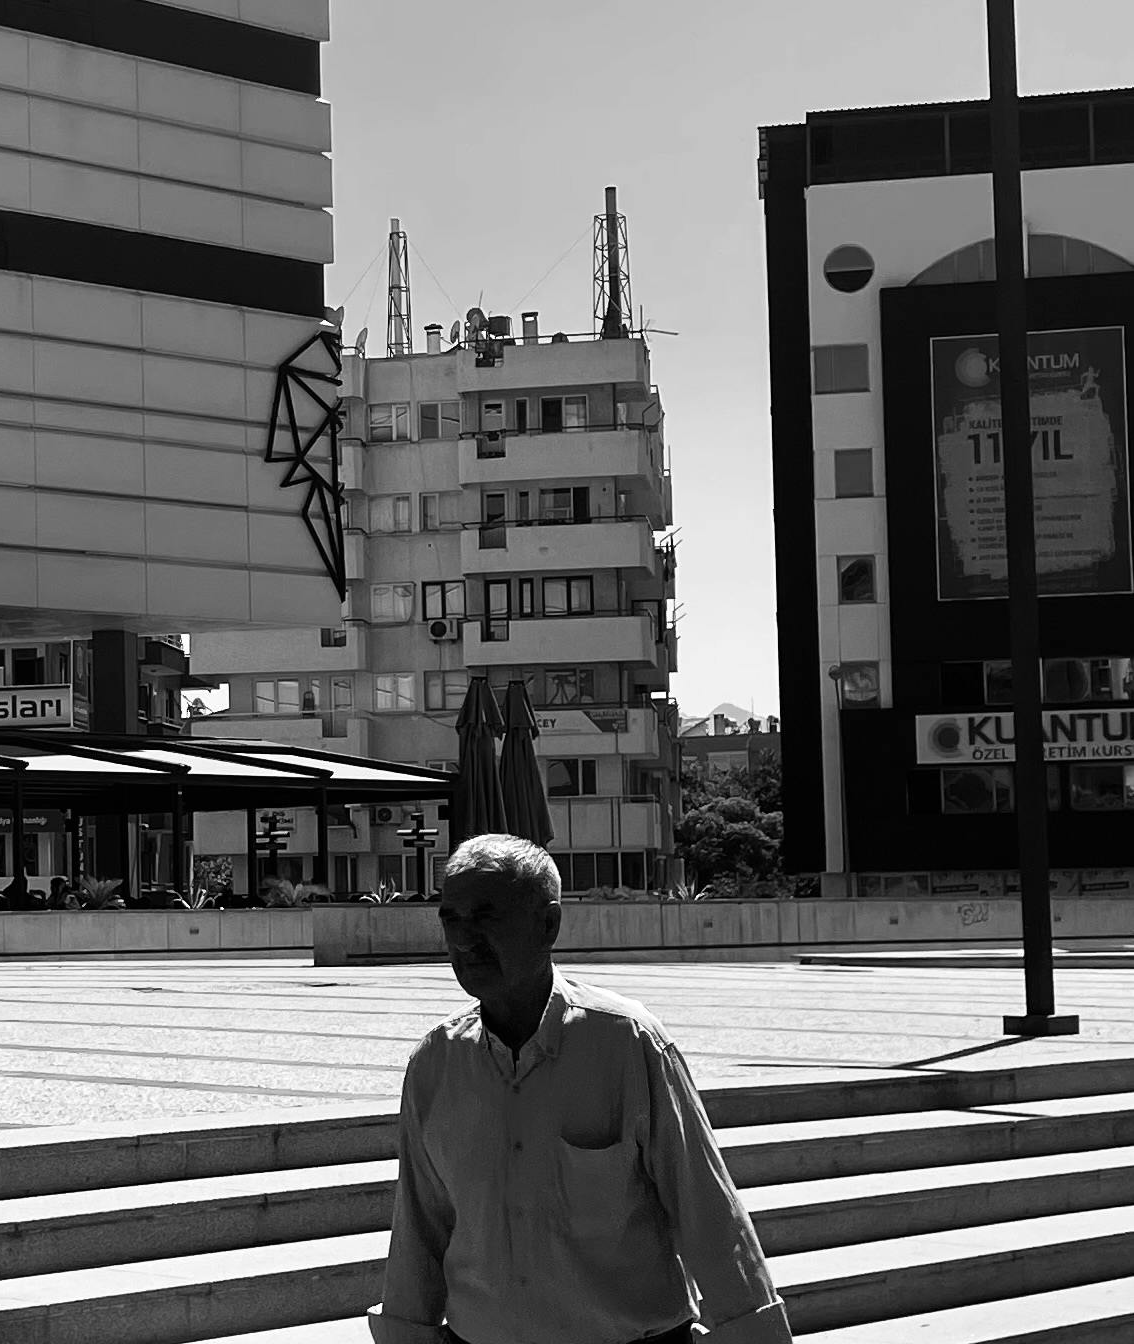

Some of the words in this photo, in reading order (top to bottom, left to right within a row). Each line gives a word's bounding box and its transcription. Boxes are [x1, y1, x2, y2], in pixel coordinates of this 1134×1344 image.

[988, 352, 1080, 373] KNTUM
[972, 747, 1009, 761] ÖZEL
[1044, 744, 1087, 759] ETİM
